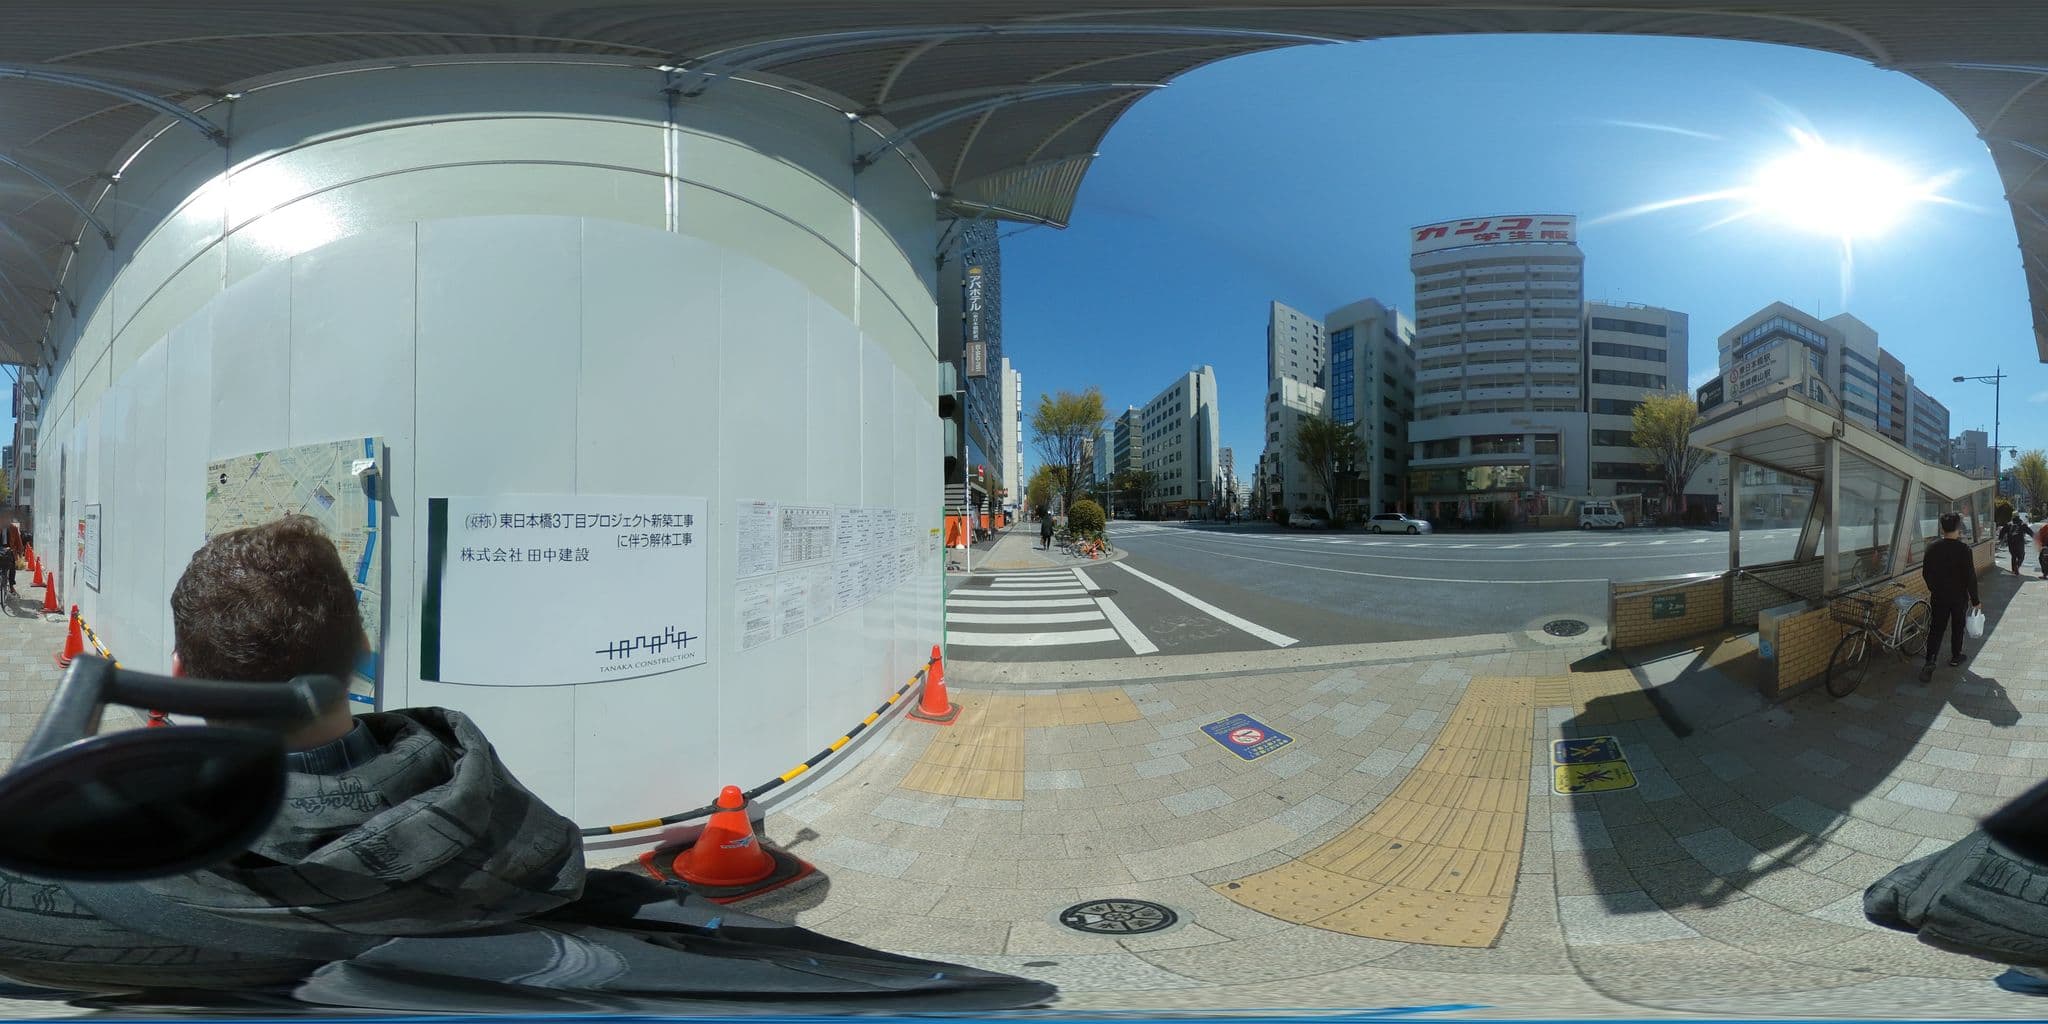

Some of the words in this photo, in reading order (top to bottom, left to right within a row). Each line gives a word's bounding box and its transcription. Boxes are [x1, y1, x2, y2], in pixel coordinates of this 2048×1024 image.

[1416, 217, 1570, 242] カンコー
[617, 532, 693, 548] に伴う解体工事
[460, 547, 524, 562] 株式会社
[528, 547, 590, 562] 田中建設
[600, 663, 633, 673] TANAKA
[634, 651, 696, 668] CONSTRUCTION
